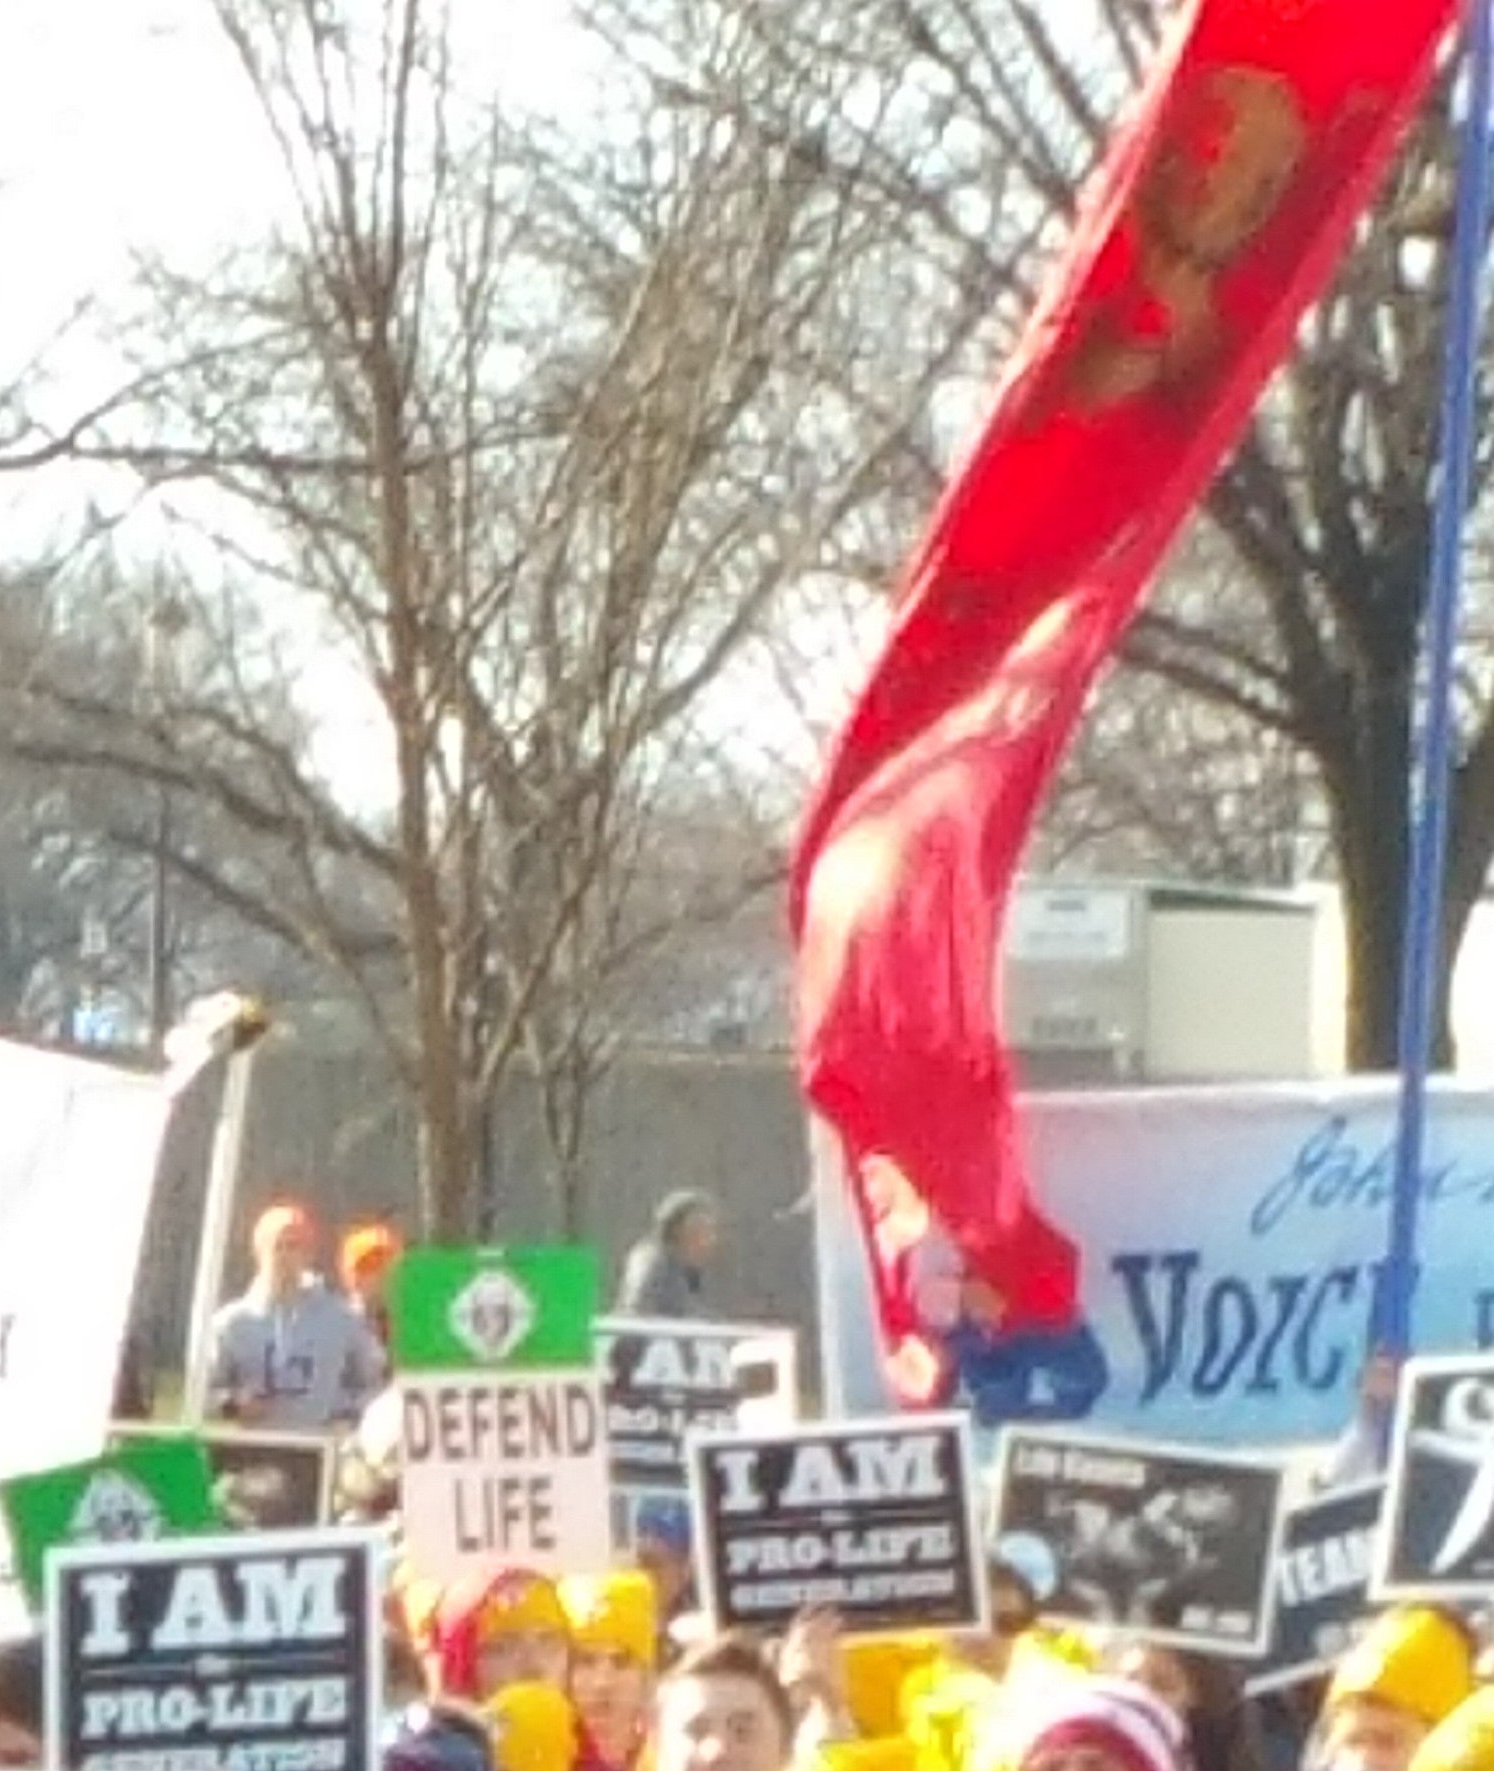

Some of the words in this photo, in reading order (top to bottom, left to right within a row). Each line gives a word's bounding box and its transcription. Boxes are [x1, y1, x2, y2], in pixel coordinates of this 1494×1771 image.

[405, 1384, 597, 1460] DEFEND
[715, 1450, 763, 1512] I
[780, 1434, 947, 1508] AM
[455, 1478, 556, 1551] LIFE
[80, 1570, 130, 1656] I
[151, 1556, 346, 1649] AM
[80, 1678, 346, 1741] PRO-LIFE
